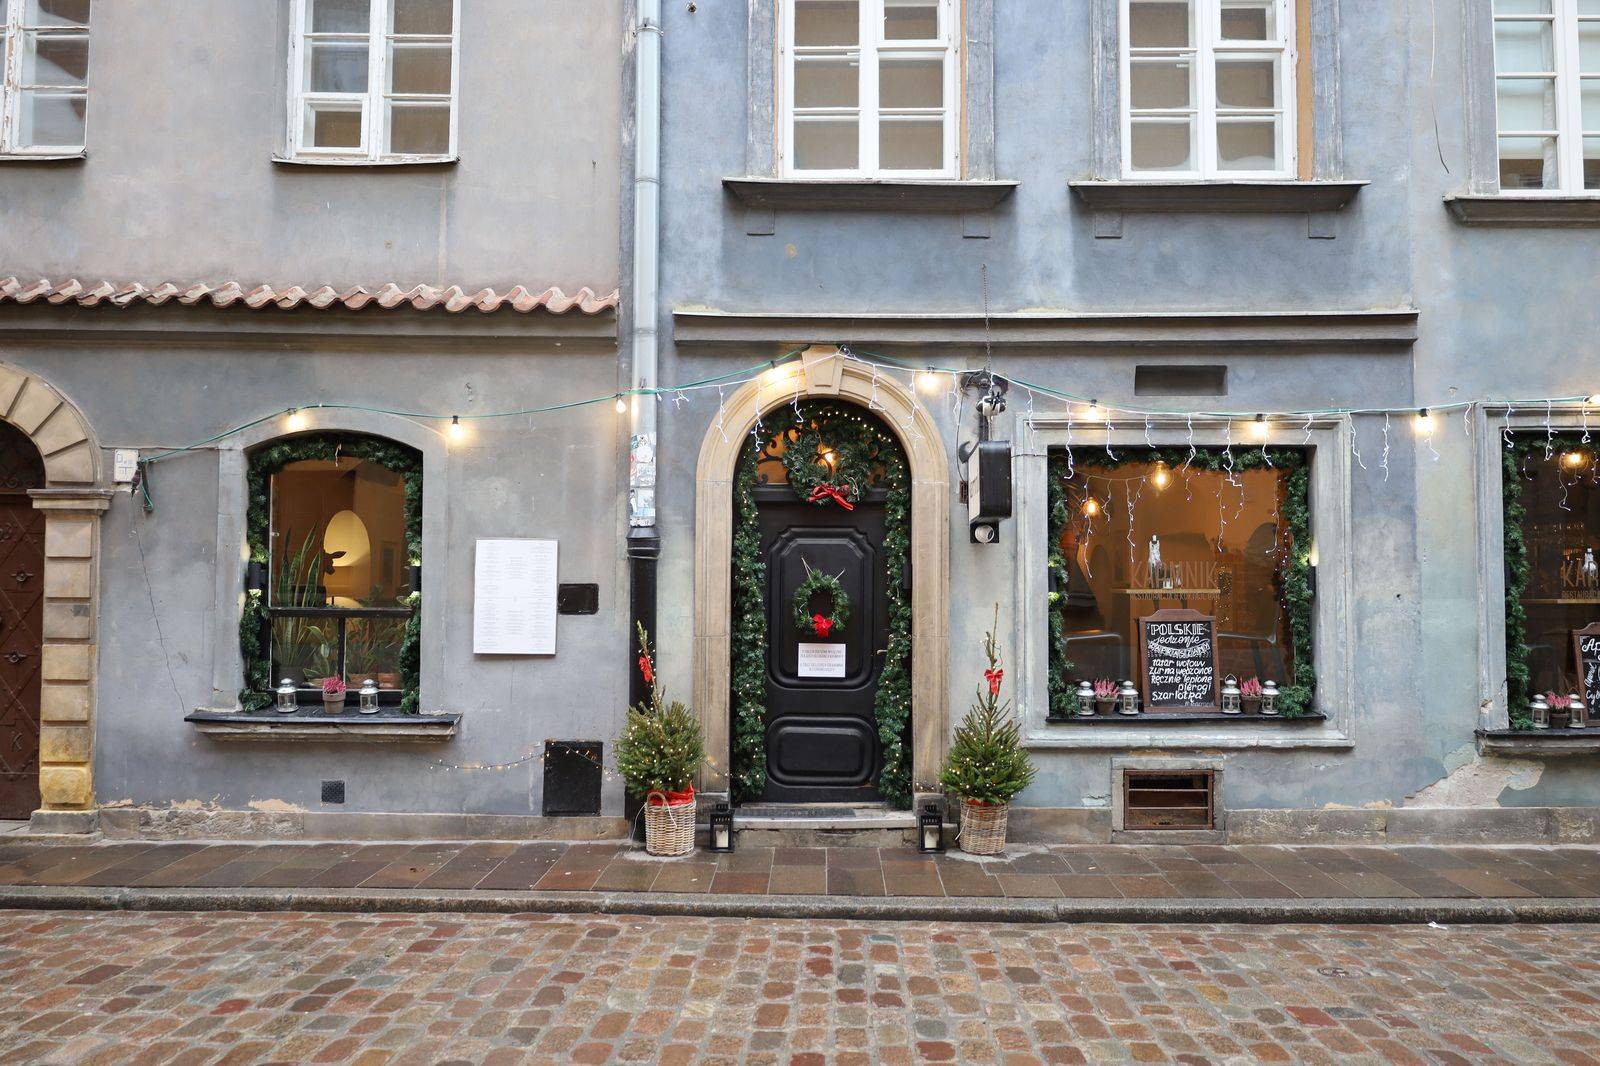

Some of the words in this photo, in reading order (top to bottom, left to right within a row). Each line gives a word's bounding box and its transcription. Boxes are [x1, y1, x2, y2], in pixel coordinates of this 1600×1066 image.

[1131, 561, 1218, 588] KARMNIK
[1150, 623, 1205, 636] POLSKIE
[1178, 683, 1211, 695] pierogi
